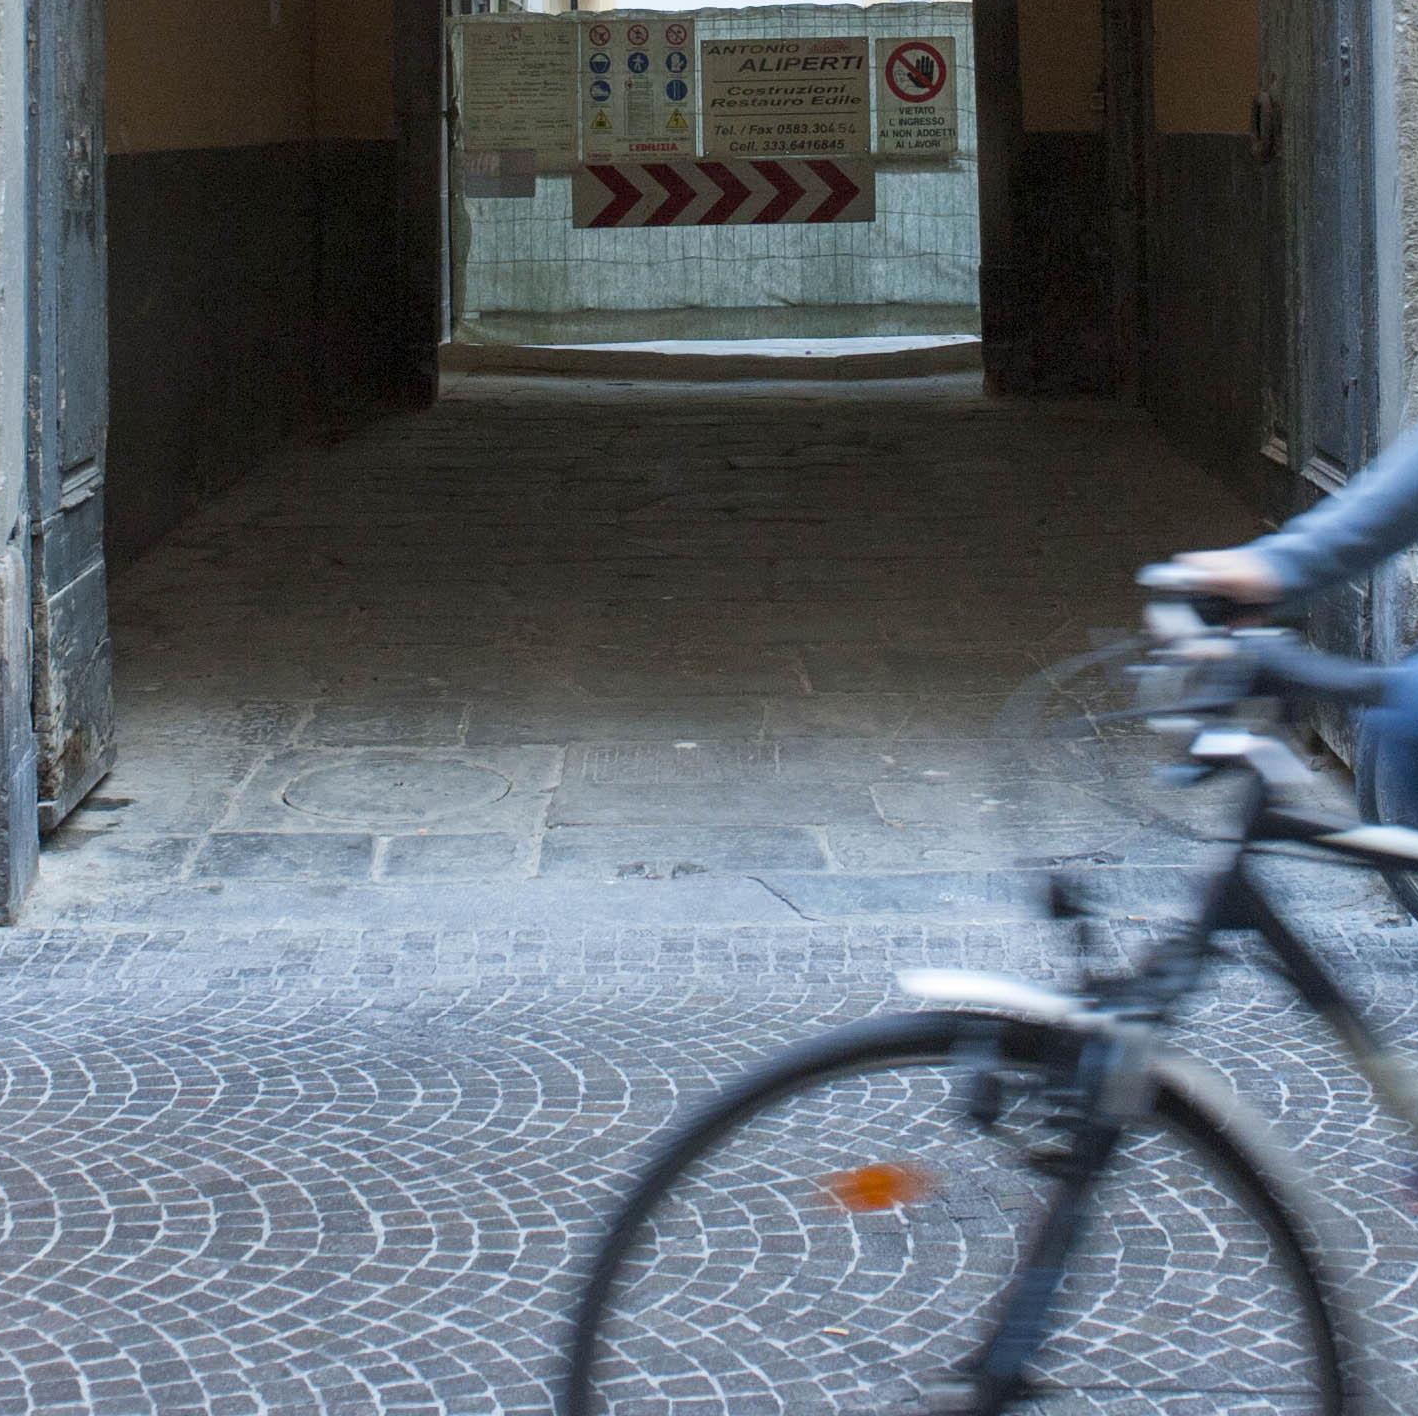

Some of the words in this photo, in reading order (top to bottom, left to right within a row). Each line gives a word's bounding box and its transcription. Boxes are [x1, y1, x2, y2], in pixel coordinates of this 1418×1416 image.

[707, 44, 799, 55] ANTONIO
[737, 56, 864, 72] ALIPERTI
[726, 84, 846, 96] Costruzioni
[710, 97, 805, 108] Restauro
[811, 95, 862, 106] Edile
[898, 106, 936, 115] VIETATO
[748, 124, 774, 135] Fax
[879, 129, 889, 137] AI
[892, 129, 913, 138] NON
[916, 128, 957, 137] ADDETTI
[728, 141, 758, 152] Cell.
[895, 140, 905, 149] AI
[908, 140, 941, 149] LAVORI
